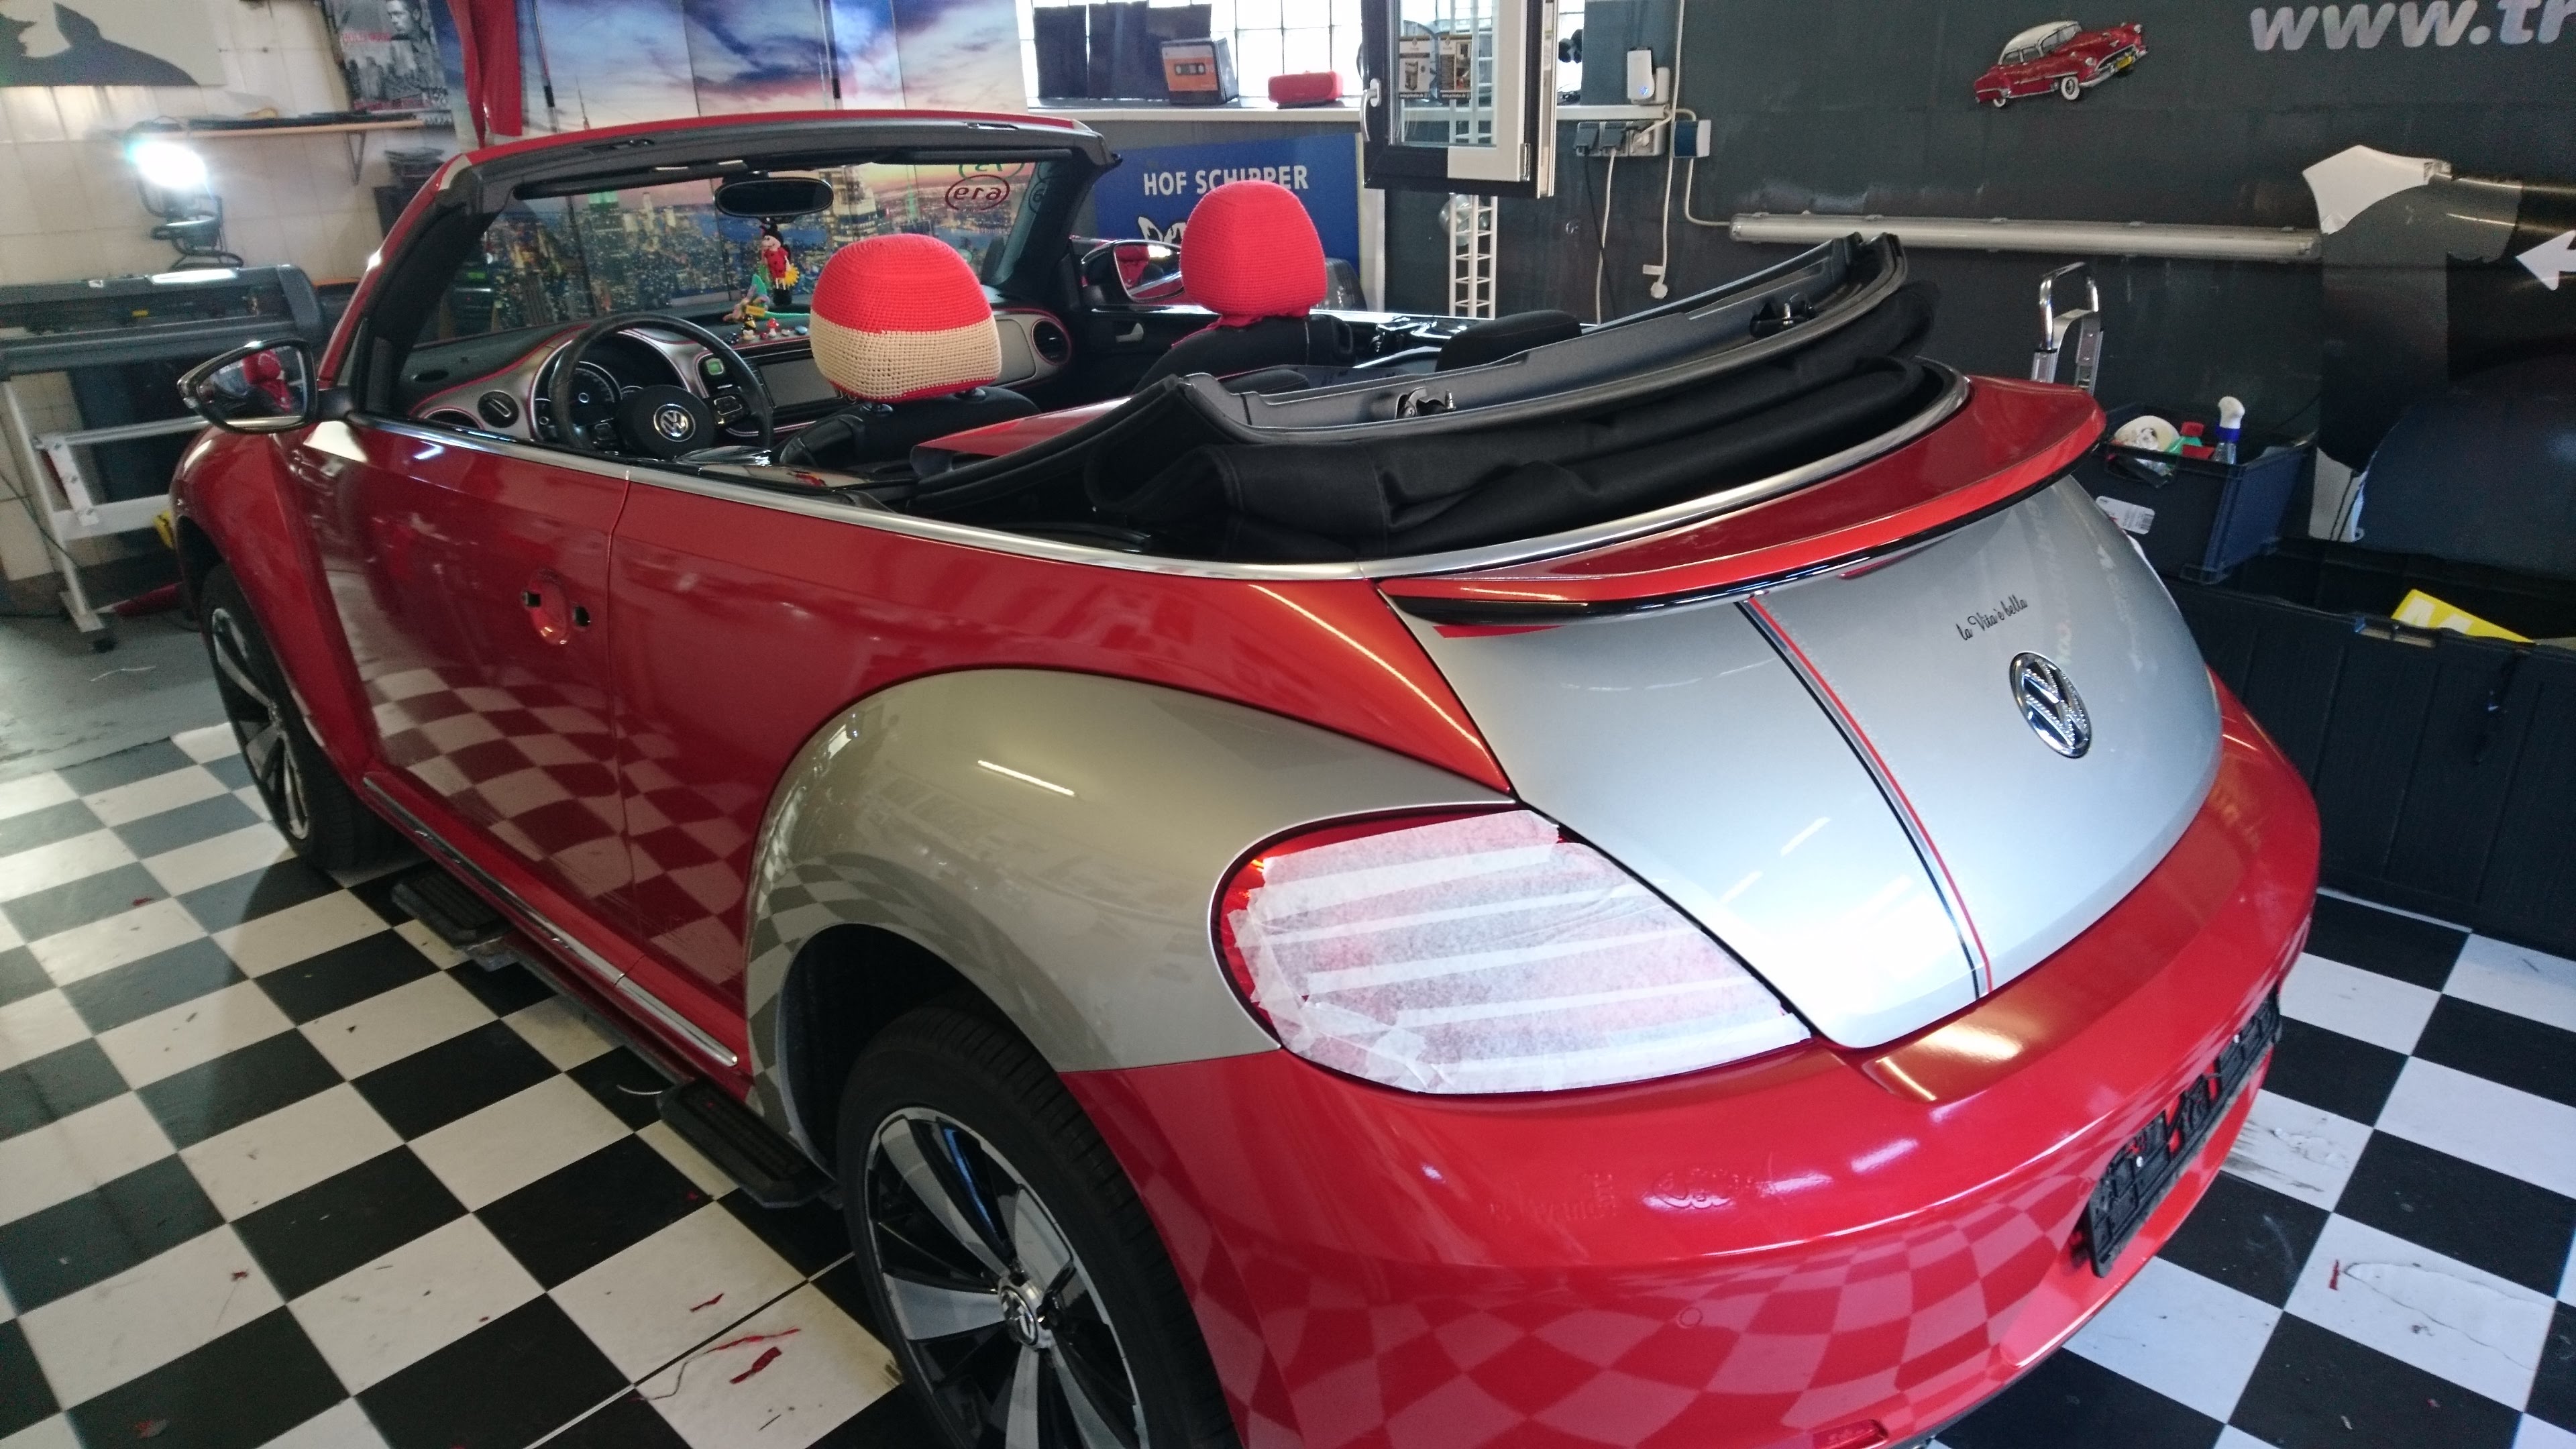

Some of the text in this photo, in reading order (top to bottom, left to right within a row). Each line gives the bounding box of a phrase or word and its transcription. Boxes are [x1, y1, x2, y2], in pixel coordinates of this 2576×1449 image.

[1144, 171, 1187, 196] HOF
[1967, 612, 1998, 632] Vita
[2000, 594, 2028, 616] bella
